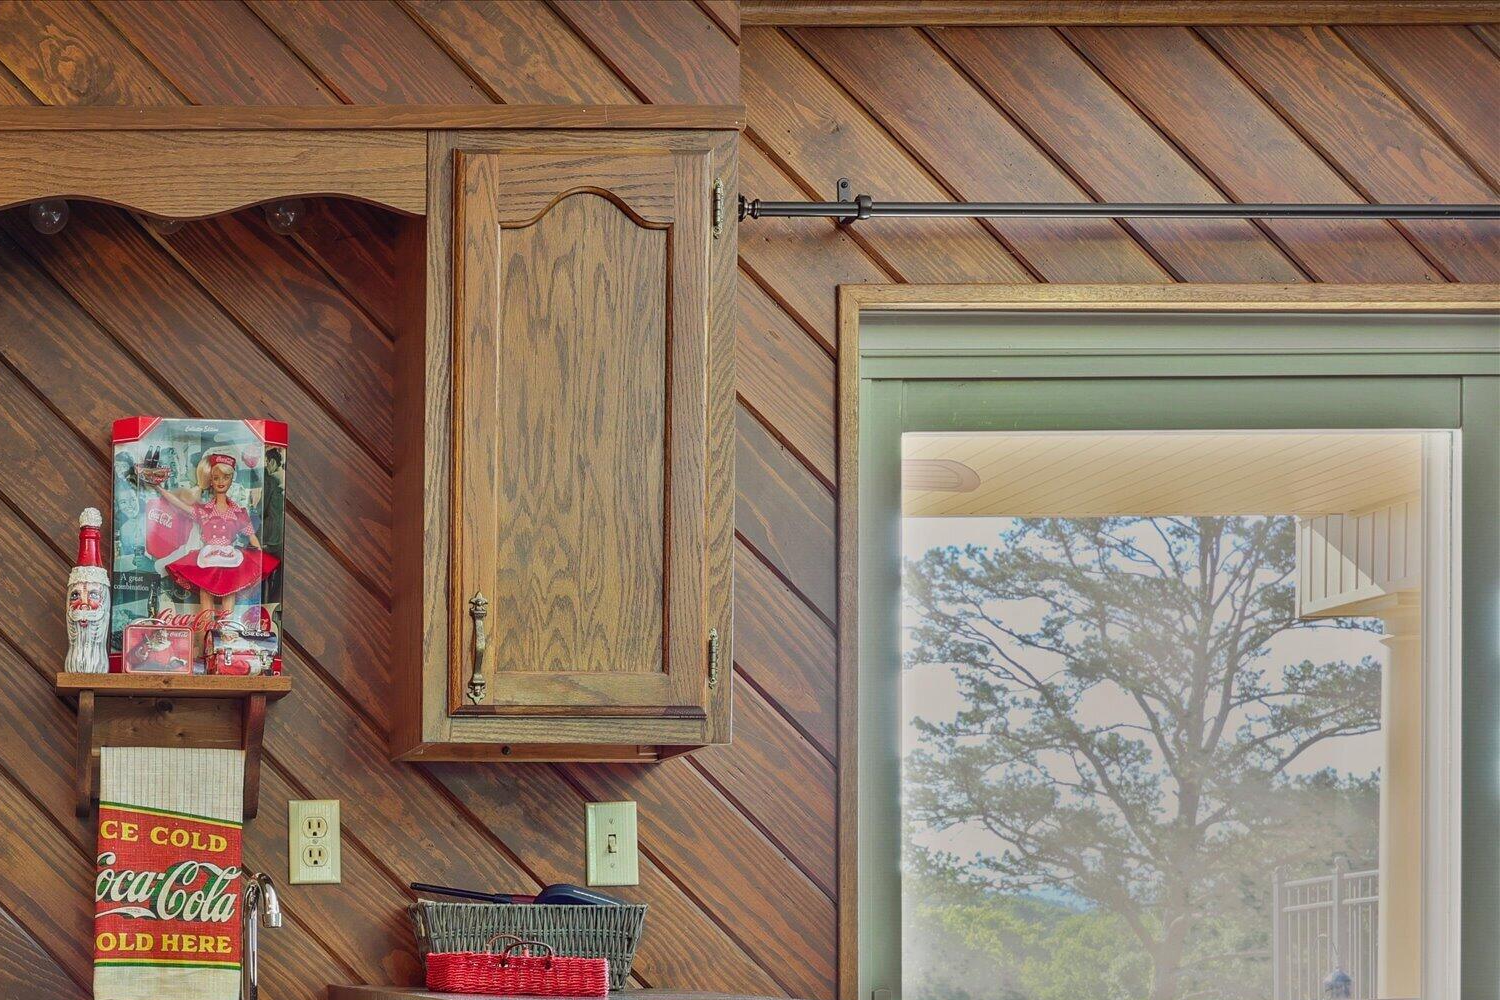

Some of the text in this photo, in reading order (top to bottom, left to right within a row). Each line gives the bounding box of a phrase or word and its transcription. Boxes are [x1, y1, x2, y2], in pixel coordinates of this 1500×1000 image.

[120, 573, 144, 583] A great
[113, 582, 149, 591] combination
[100, 820, 228, 852] CE COLD
[96, 932, 232, 954] OLD HERE
